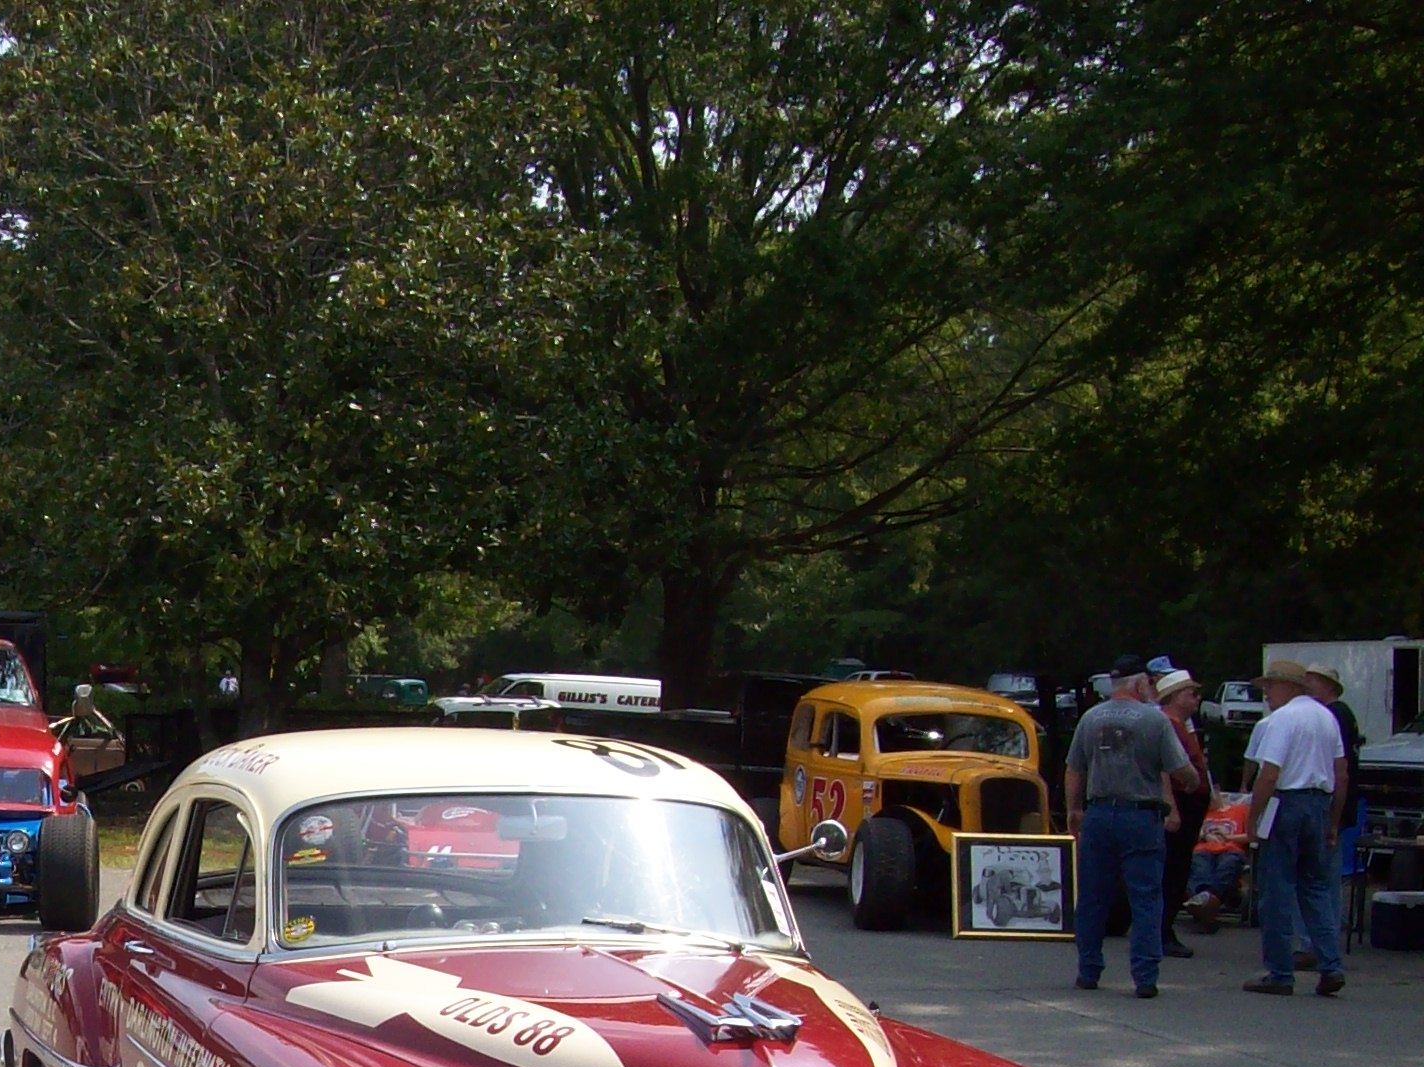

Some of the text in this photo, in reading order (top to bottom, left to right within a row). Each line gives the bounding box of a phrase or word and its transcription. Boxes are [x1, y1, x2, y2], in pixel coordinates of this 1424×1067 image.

[558, 691, 608, 705] GILLIS'S
[810, 776, 847, 822] 52
[439, 997, 576, 1056] OLDS 88
